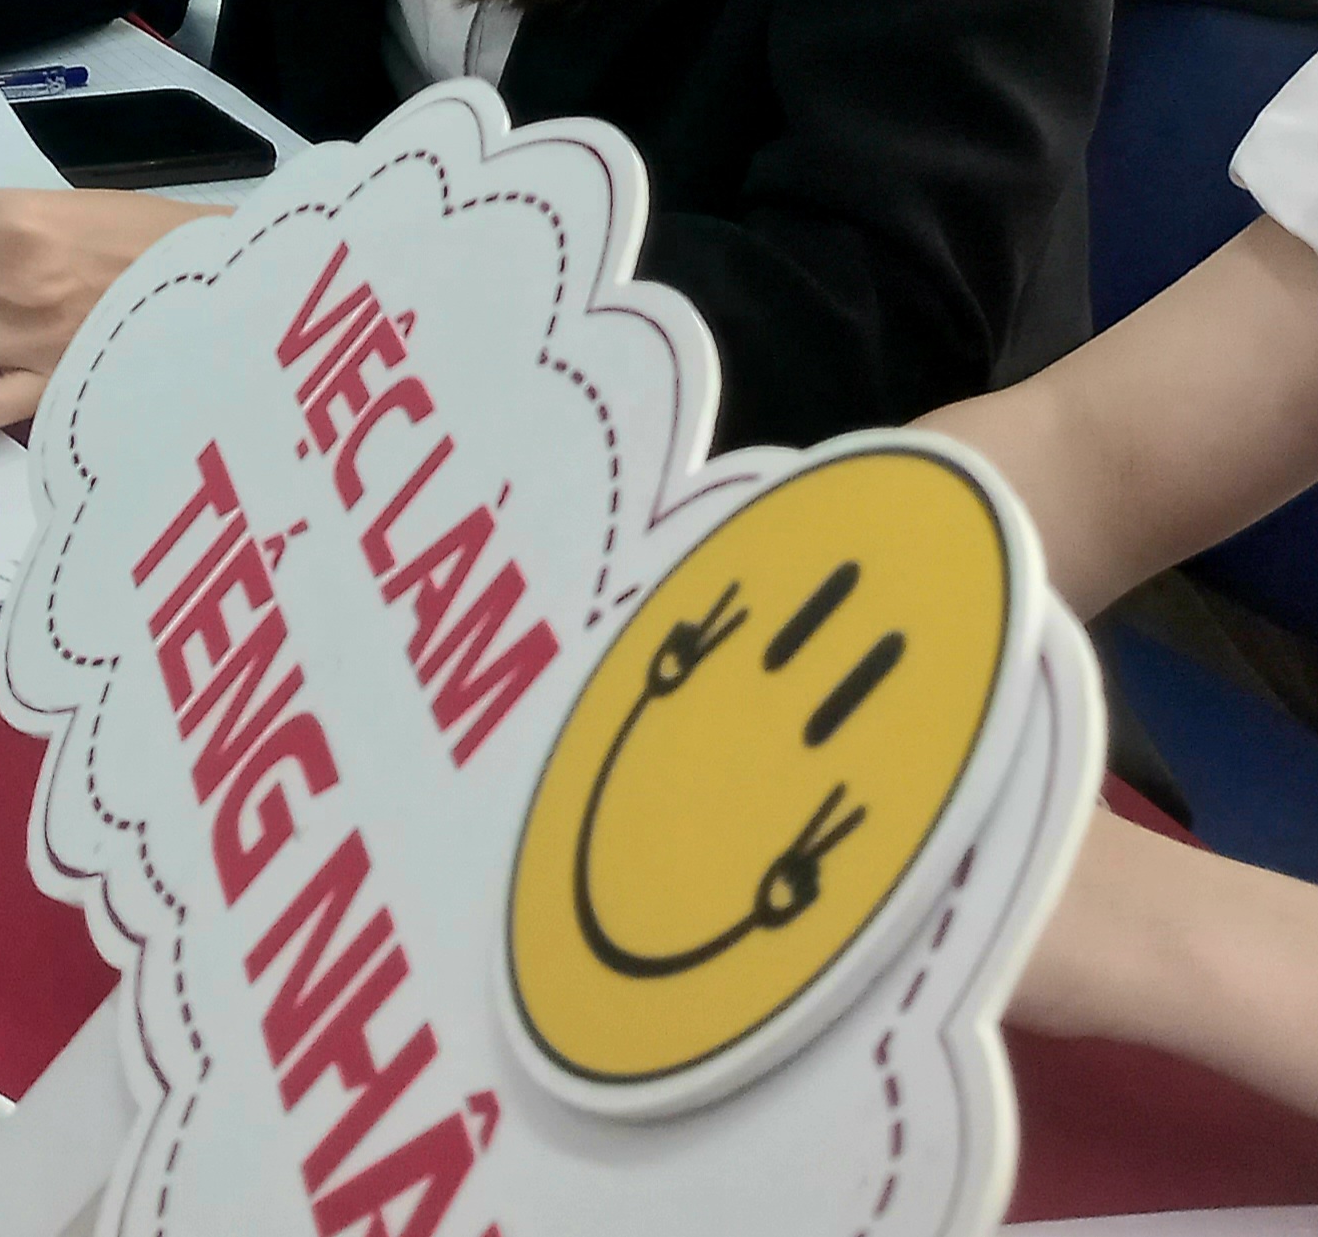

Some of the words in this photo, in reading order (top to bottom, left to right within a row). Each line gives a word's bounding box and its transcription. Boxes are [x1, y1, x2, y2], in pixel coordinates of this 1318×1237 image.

[276, 241, 435, 509] VIỆC
[360, 437, 560, 768] LÀM
[132, 439, 340, 908] TIẾNG
[244, 829, 502, 1237] NHÂ
